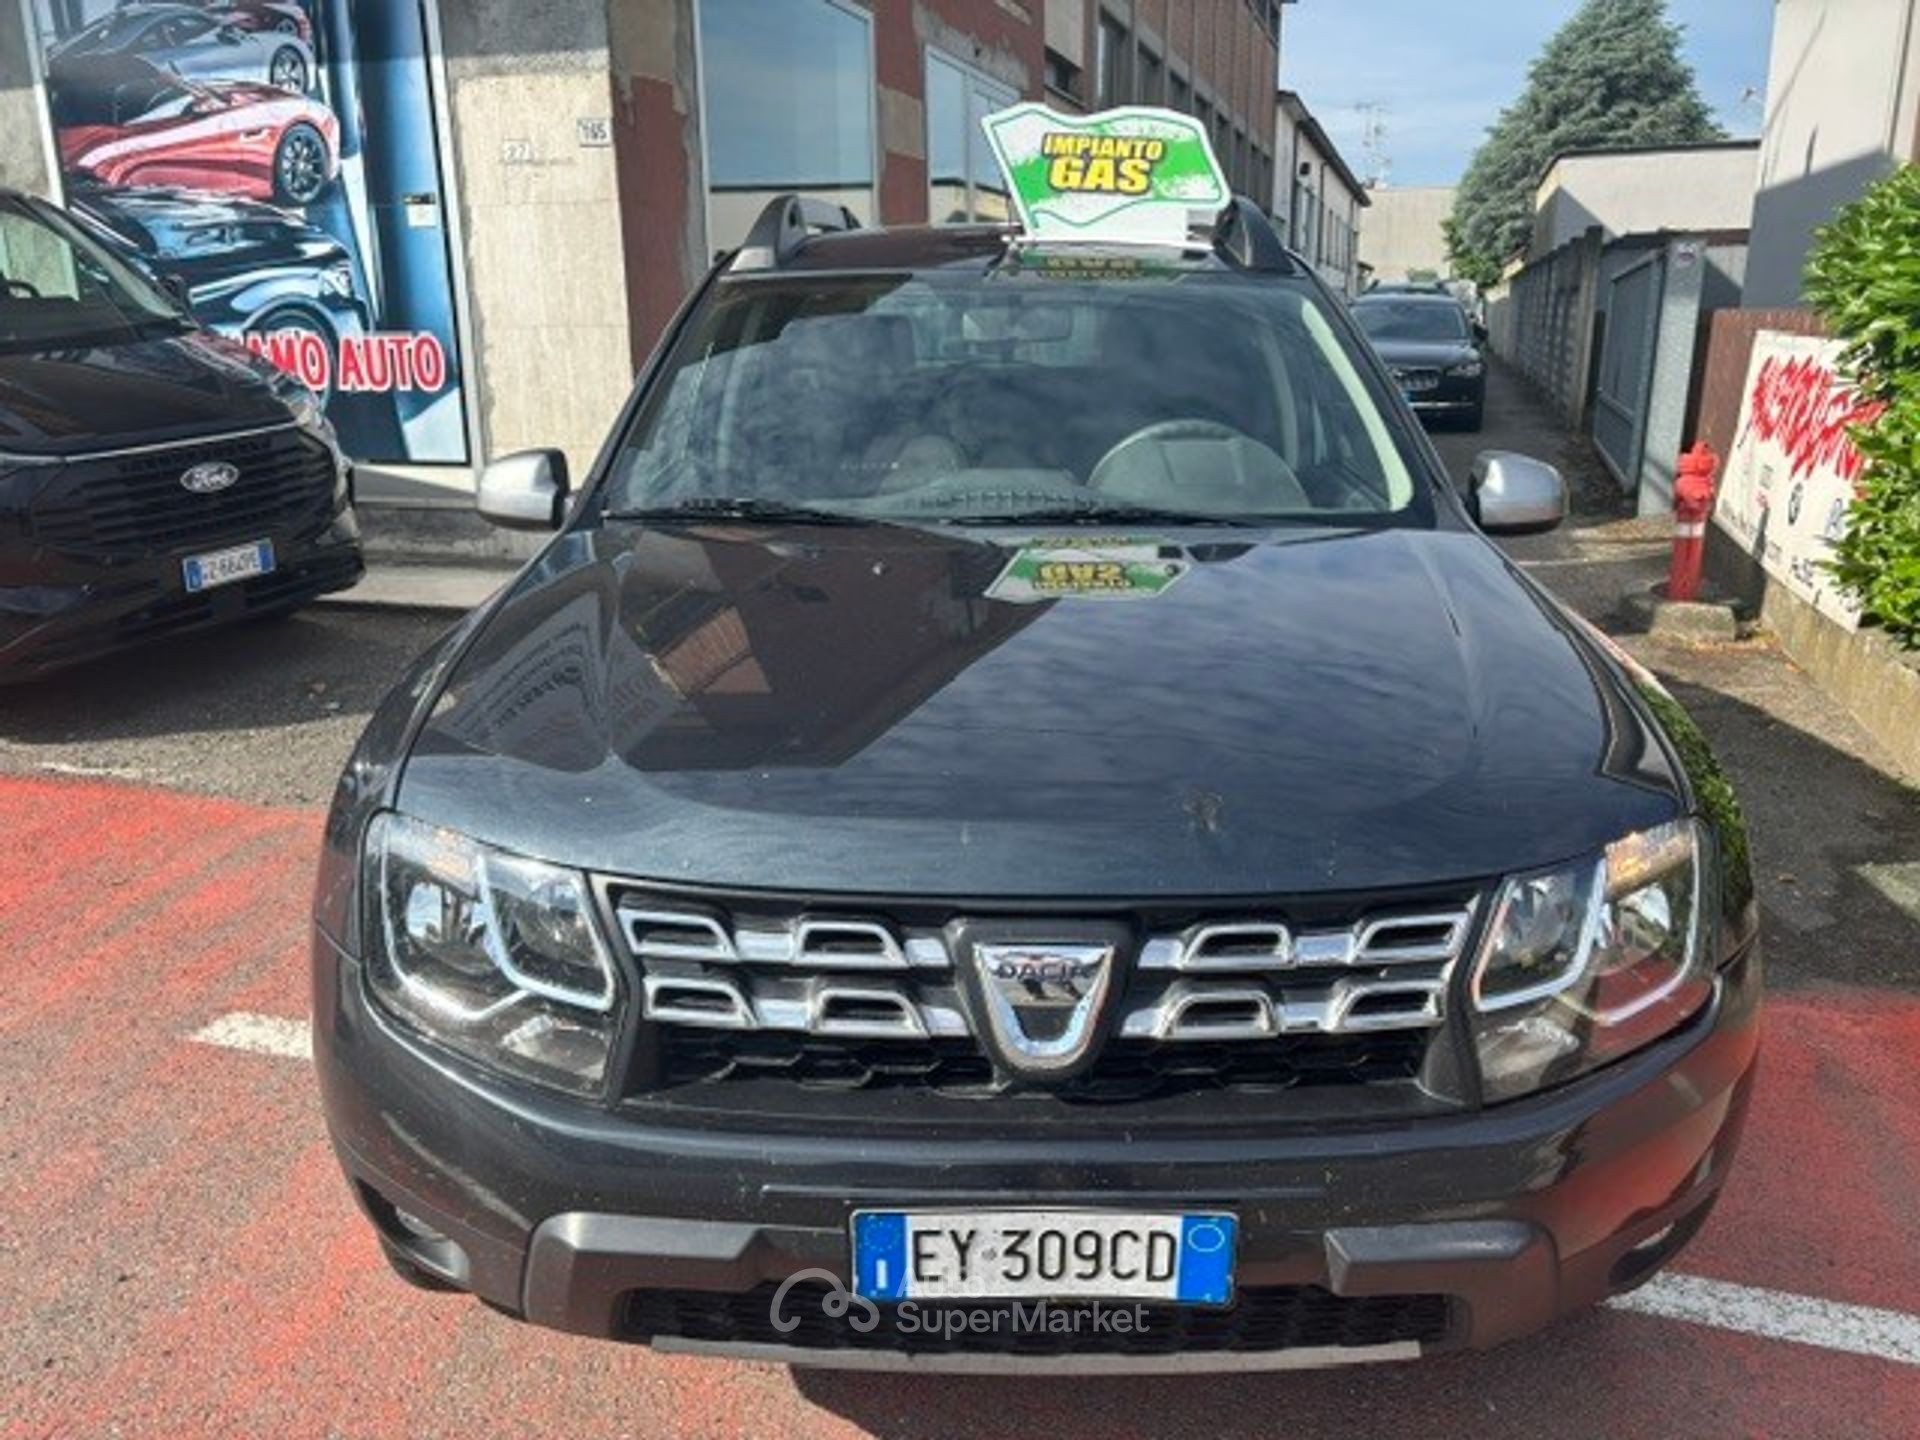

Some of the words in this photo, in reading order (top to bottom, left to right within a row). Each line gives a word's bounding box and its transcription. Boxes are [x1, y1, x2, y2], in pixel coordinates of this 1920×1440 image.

[1042, 133, 1165, 161] IMPIANTO
[1048, 157, 1154, 195] GAS
[339, 334, 445, 392] AUTO
[992, 960, 1089, 980] DACIA
[911, 1229, 977, 1284] EY
[1000, 1228, 1179, 1284] 309CD
